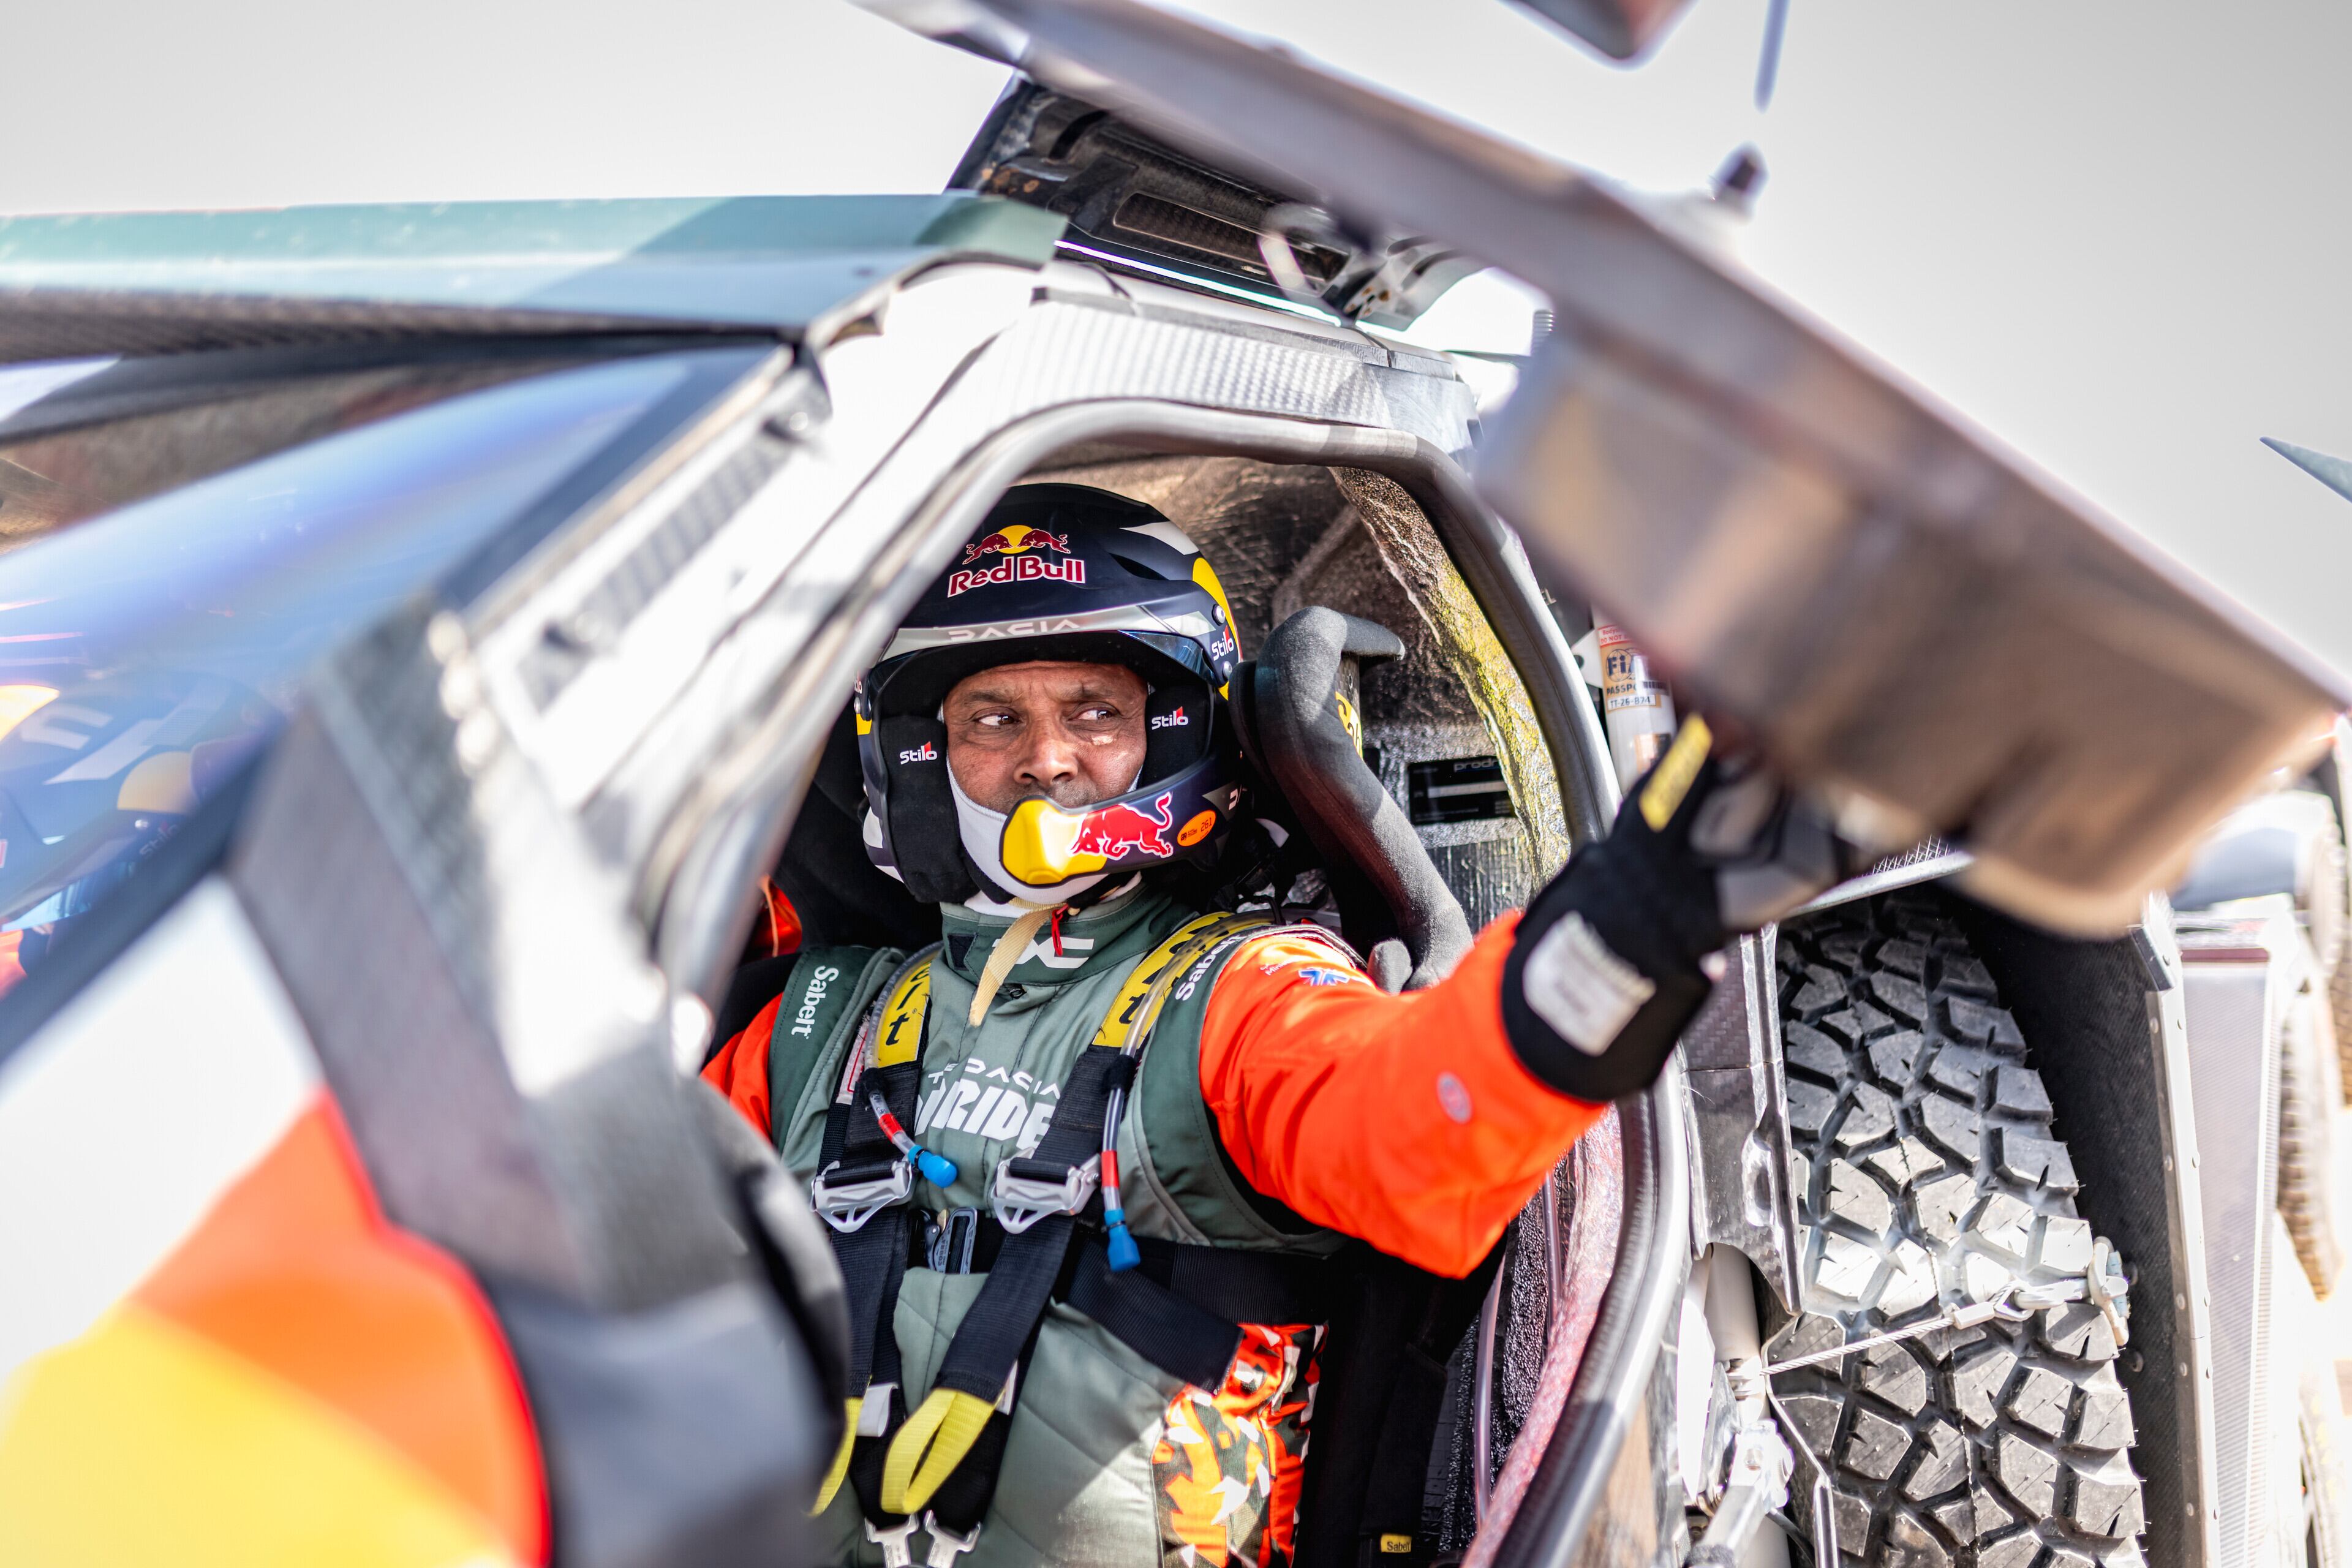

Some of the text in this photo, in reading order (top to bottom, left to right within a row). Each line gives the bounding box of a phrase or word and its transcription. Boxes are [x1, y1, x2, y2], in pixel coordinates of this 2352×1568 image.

[948, 556, 1085, 598] Red Bull
[948, 619, 1080, 641] DACIA
[1212, 628, 1234, 662] Stilo
[1607, 683, 1637, 696] PASSP
[1152, 708, 1188, 730] Stilo
[900, 743, 938, 765] Stilo
[1453, 758, 1499, 772] prodr
[791, 965, 839, 1037] Sabelt
[965, 1058, 1061, 1100] DACIA
